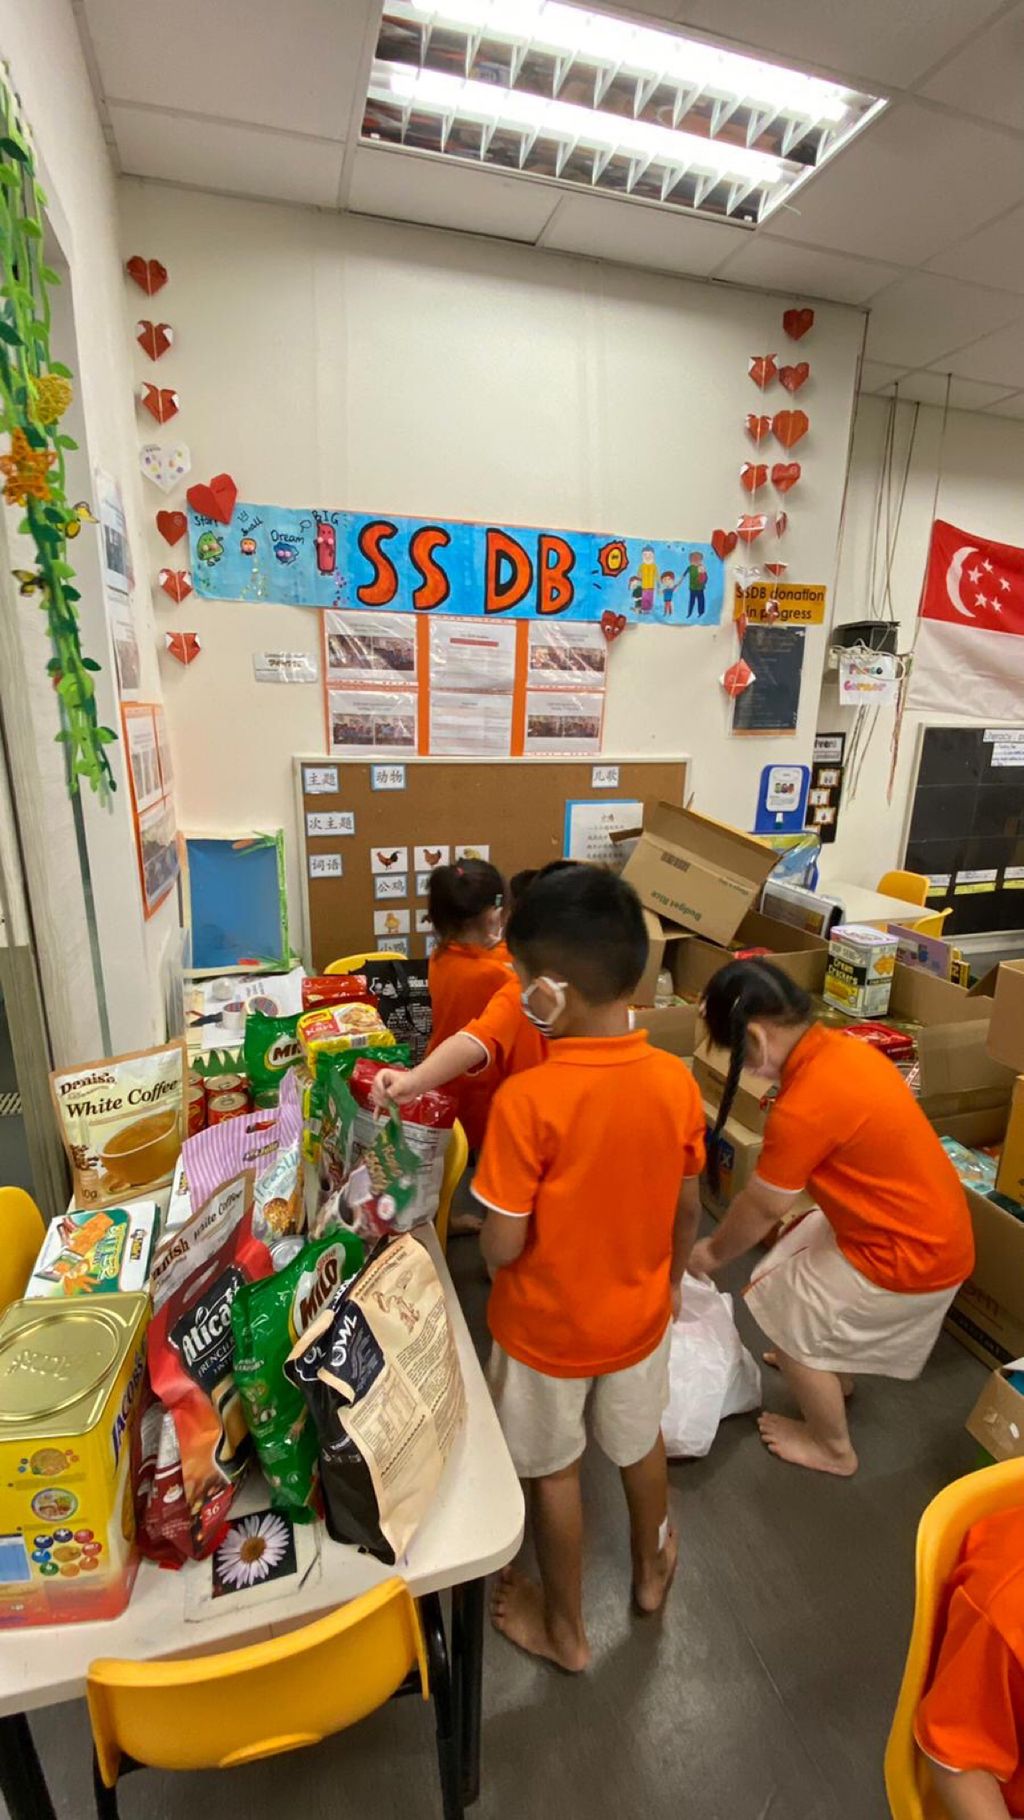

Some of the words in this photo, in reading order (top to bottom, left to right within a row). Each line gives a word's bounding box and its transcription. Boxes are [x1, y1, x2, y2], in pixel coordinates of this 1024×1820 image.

[270, 529, 305, 545] Dream
[736, 586, 767, 600] SSDB
[770, 587, 824, 602] donation
[746, 604, 757, 618] in
[307, 772, 336, 786] 主题
[376, 770, 403, 784] 动物
[309, 816, 353, 830] 次主题
[312, 858, 340, 872] 词语
[669, 899, 702, 922] Budget
[66, 1096, 123, 1118] White
[127, 1079, 179, 1106] Coffee
[301, 1258, 338, 1331] MILO
[330, 1314, 358, 1367] OWL
[204, 1504, 220, 1520] 36
